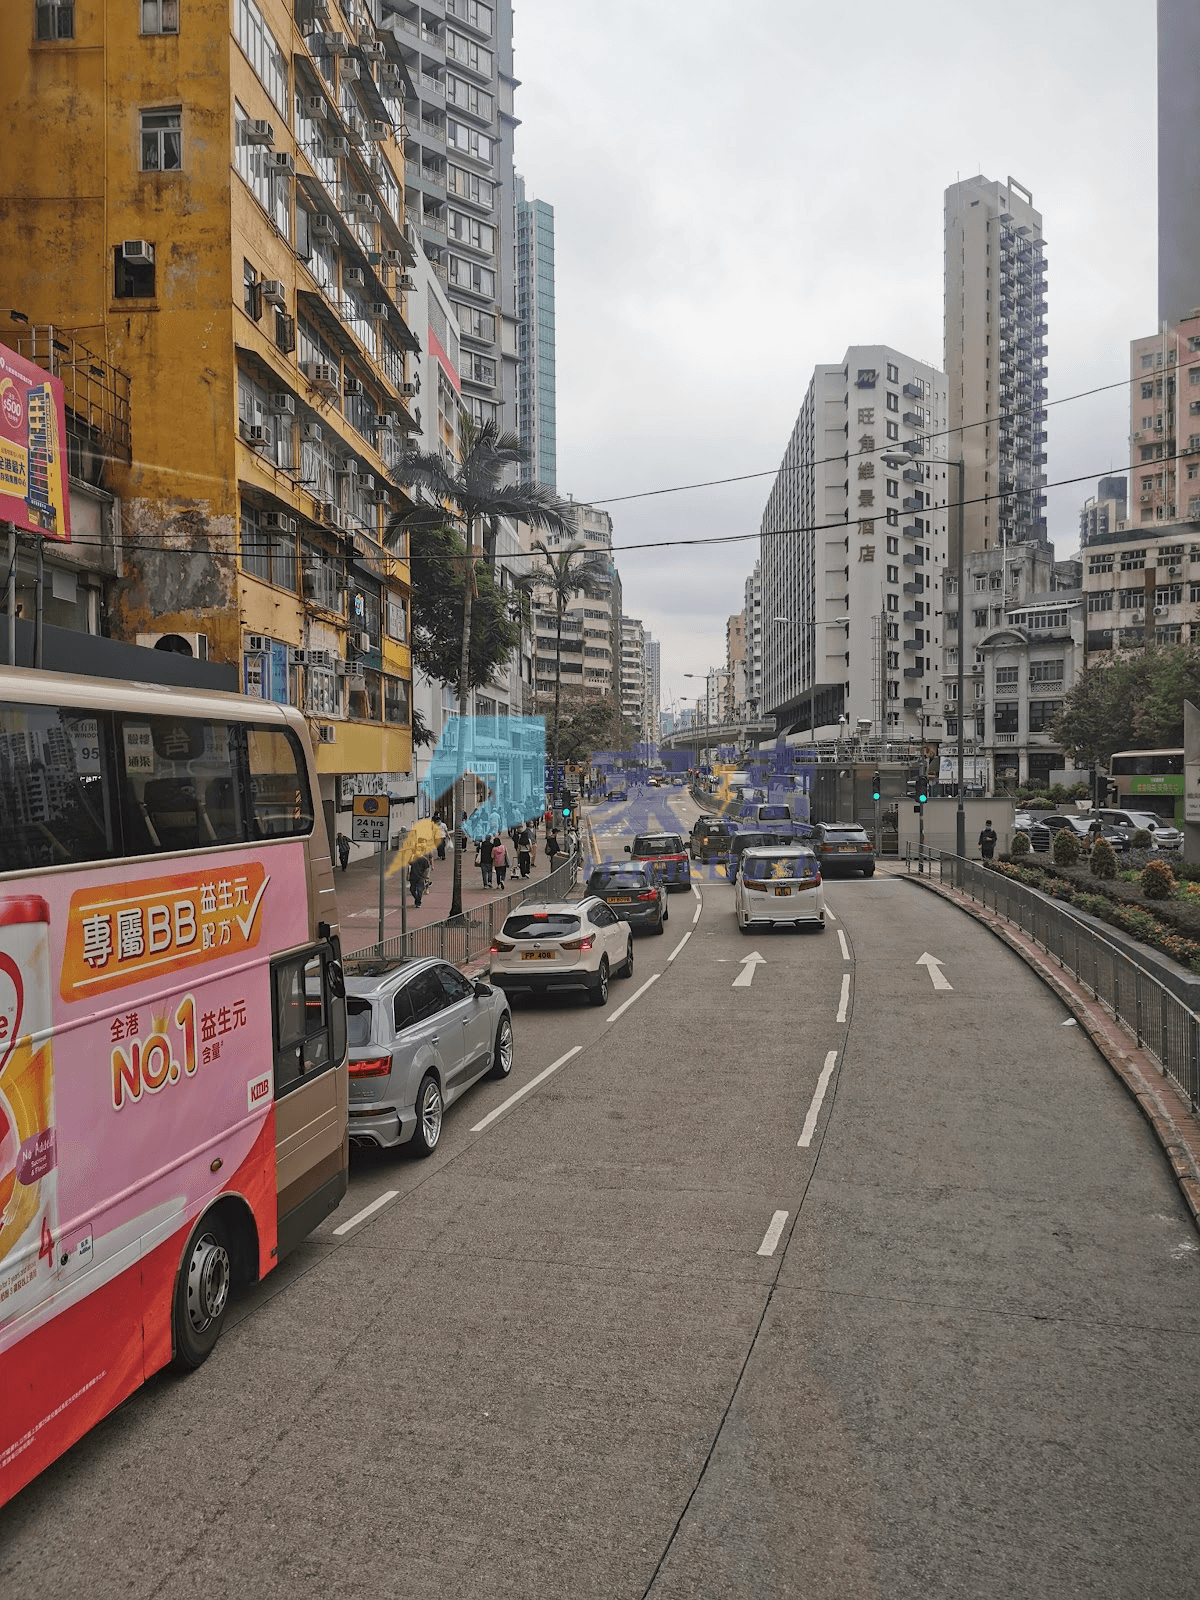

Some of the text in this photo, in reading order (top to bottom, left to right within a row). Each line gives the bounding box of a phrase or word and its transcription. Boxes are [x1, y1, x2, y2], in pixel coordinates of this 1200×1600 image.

[3, 398, 22, 417] $500
[857, 407, 876, 563] 旺角維景酒店
[360, 828, 381, 839] 全日
[371, 819, 384, 827] hrs
[200, 877, 250, 915] 益生元
[202, 918, 232, 951] 配方
[110, 1011, 139, 1043] 全港
[201, 999, 247, 1043] 益生元
[111, 993, 199, 1111] NO.1
[251, 1079, 269, 1103] KMB
[22, 1149, 32, 1162] No
[38, 1216, 55, 1268] 4
